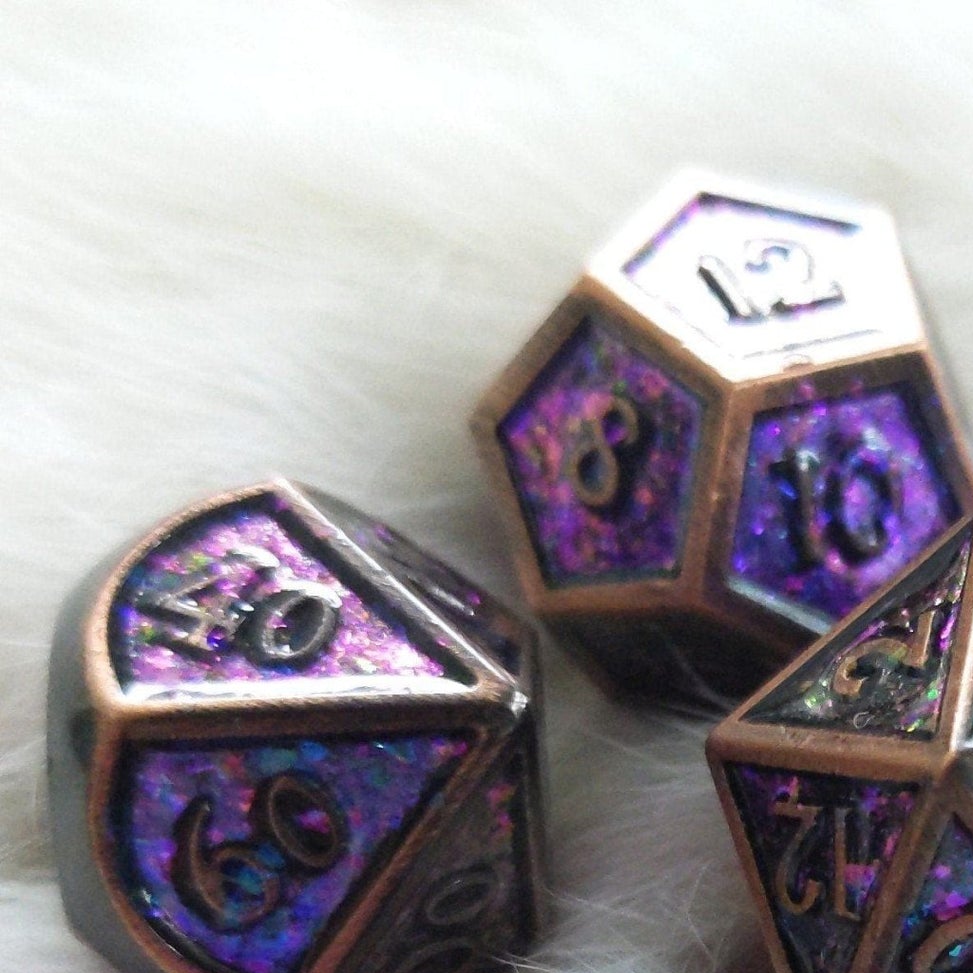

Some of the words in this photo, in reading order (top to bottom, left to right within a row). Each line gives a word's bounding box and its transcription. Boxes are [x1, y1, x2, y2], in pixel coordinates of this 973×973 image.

[698, 237, 846, 323] 12
[571, 398, 640, 508] 8
[766, 425, 903, 574] 10
[132, 543, 342, 663] 40
[185, 773, 343, 924] 60
[773, 798, 880, 921] 12
